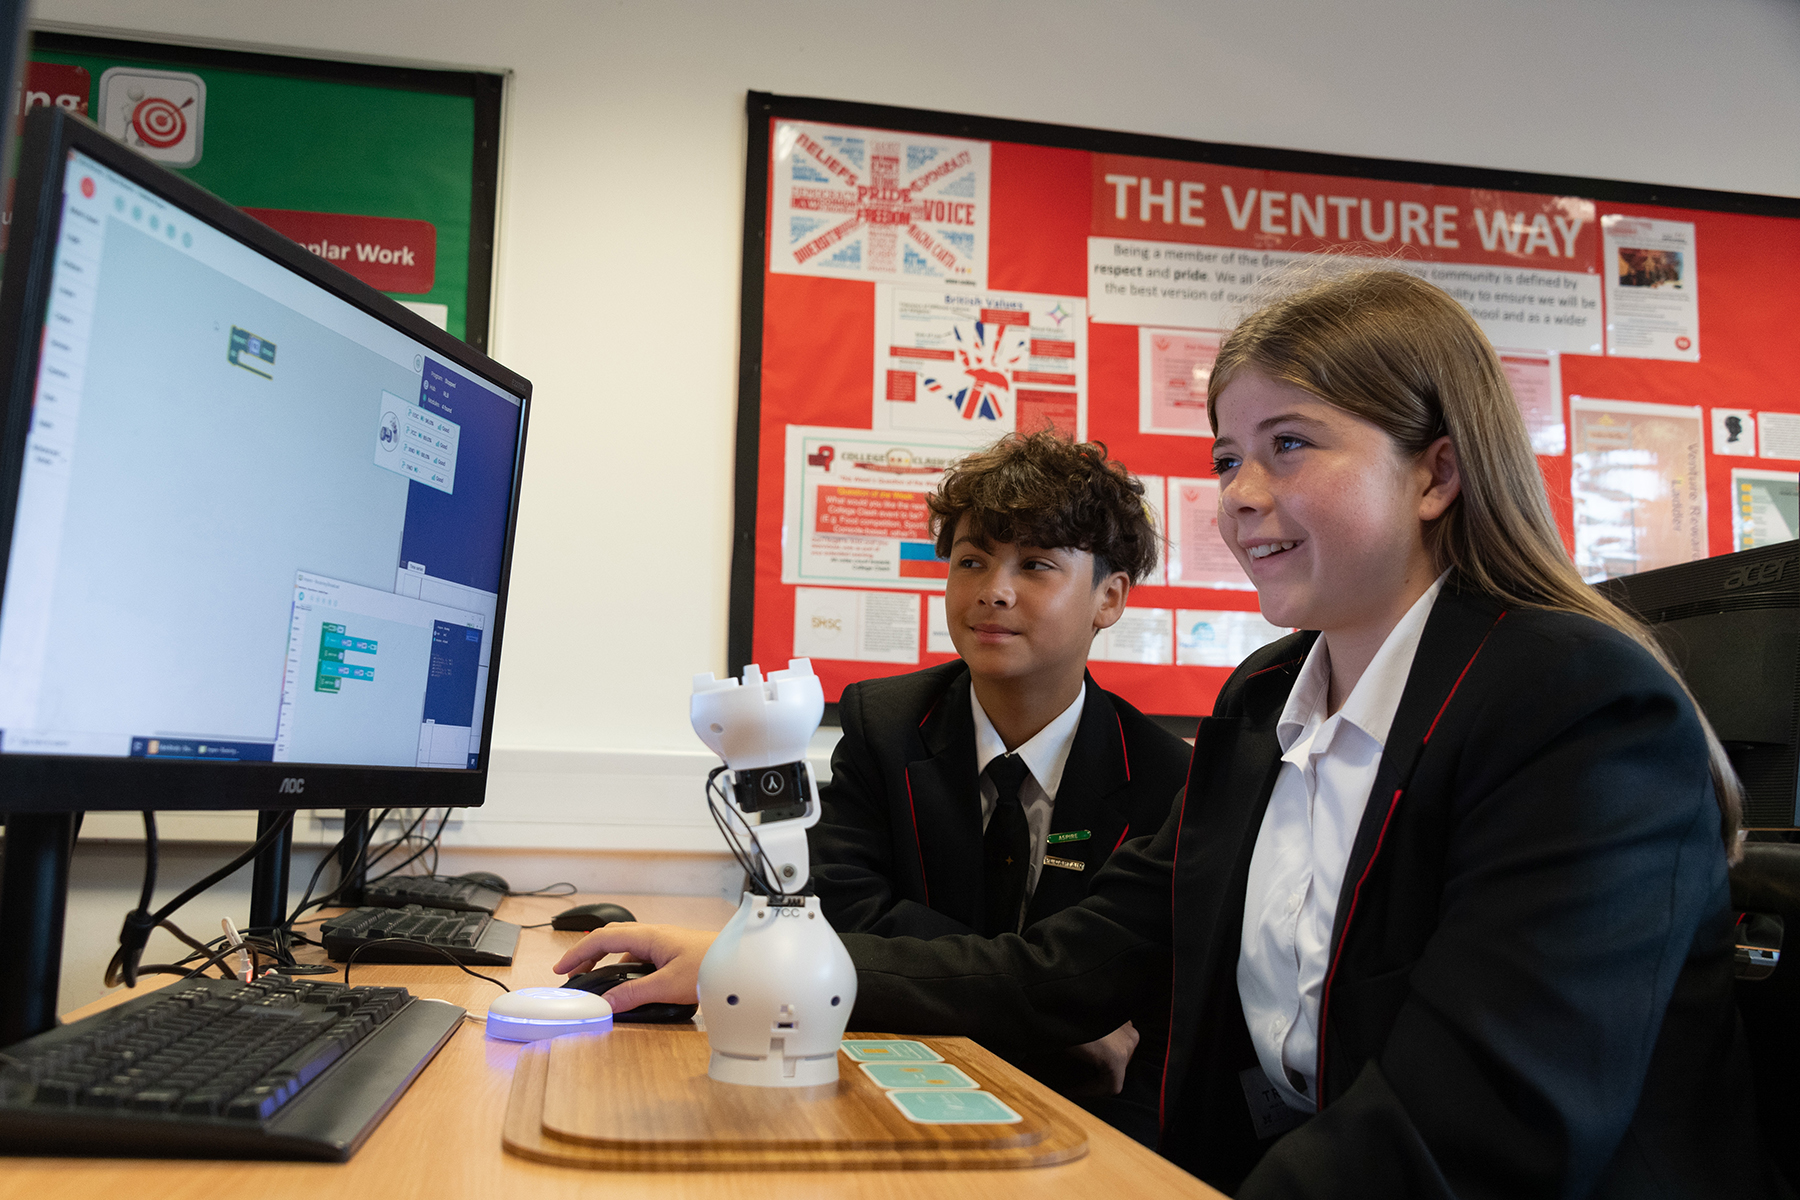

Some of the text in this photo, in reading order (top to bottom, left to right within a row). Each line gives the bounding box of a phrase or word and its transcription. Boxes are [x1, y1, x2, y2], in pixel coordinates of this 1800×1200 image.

[857, 185, 912, 203] PRIDE
[923, 199, 976, 226] VOICE
[1105, 173, 1583, 258] THE VENTURE WAY
[356, 243, 415, 266] Work
[1113, 243, 1150, 261] Being
[1153, 250, 1161, 259] a
[1164, 249, 1218, 263] member
[1221, 252, 1236, 265] of
[1238, 253, 1259, 265] the
[1094, 264, 1143, 278] respect
[1146, 267, 1171, 279] and
[1215, 272, 1236, 284] We
[1431, 269, 1500, 285] community
[1502, 272, 1513, 284] is
[1516, 272, 1561, 288] defined
[1563, 276, 1578, 291] by
[1105, 283, 1126, 295] the
[1130, 284, 1158, 298] best
[1161, 287, 1207, 301] version
[1210, 289, 1225, 303] of
[1478, 290, 1491, 302] to
[1494, 292, 1535, 305] ensure
[1538, 297, 1555, 307] we
[1558, 295, 1578, 308] will
[1581, 297, 1596, 309] be
[1502, 309, 1525, 322] and
[1528, 312, 1540, 324] as
[1554, 313, 1587, 327] wider
[1725, 557, 1798, 589] acer
[279, 777, 305, 794] AOC
